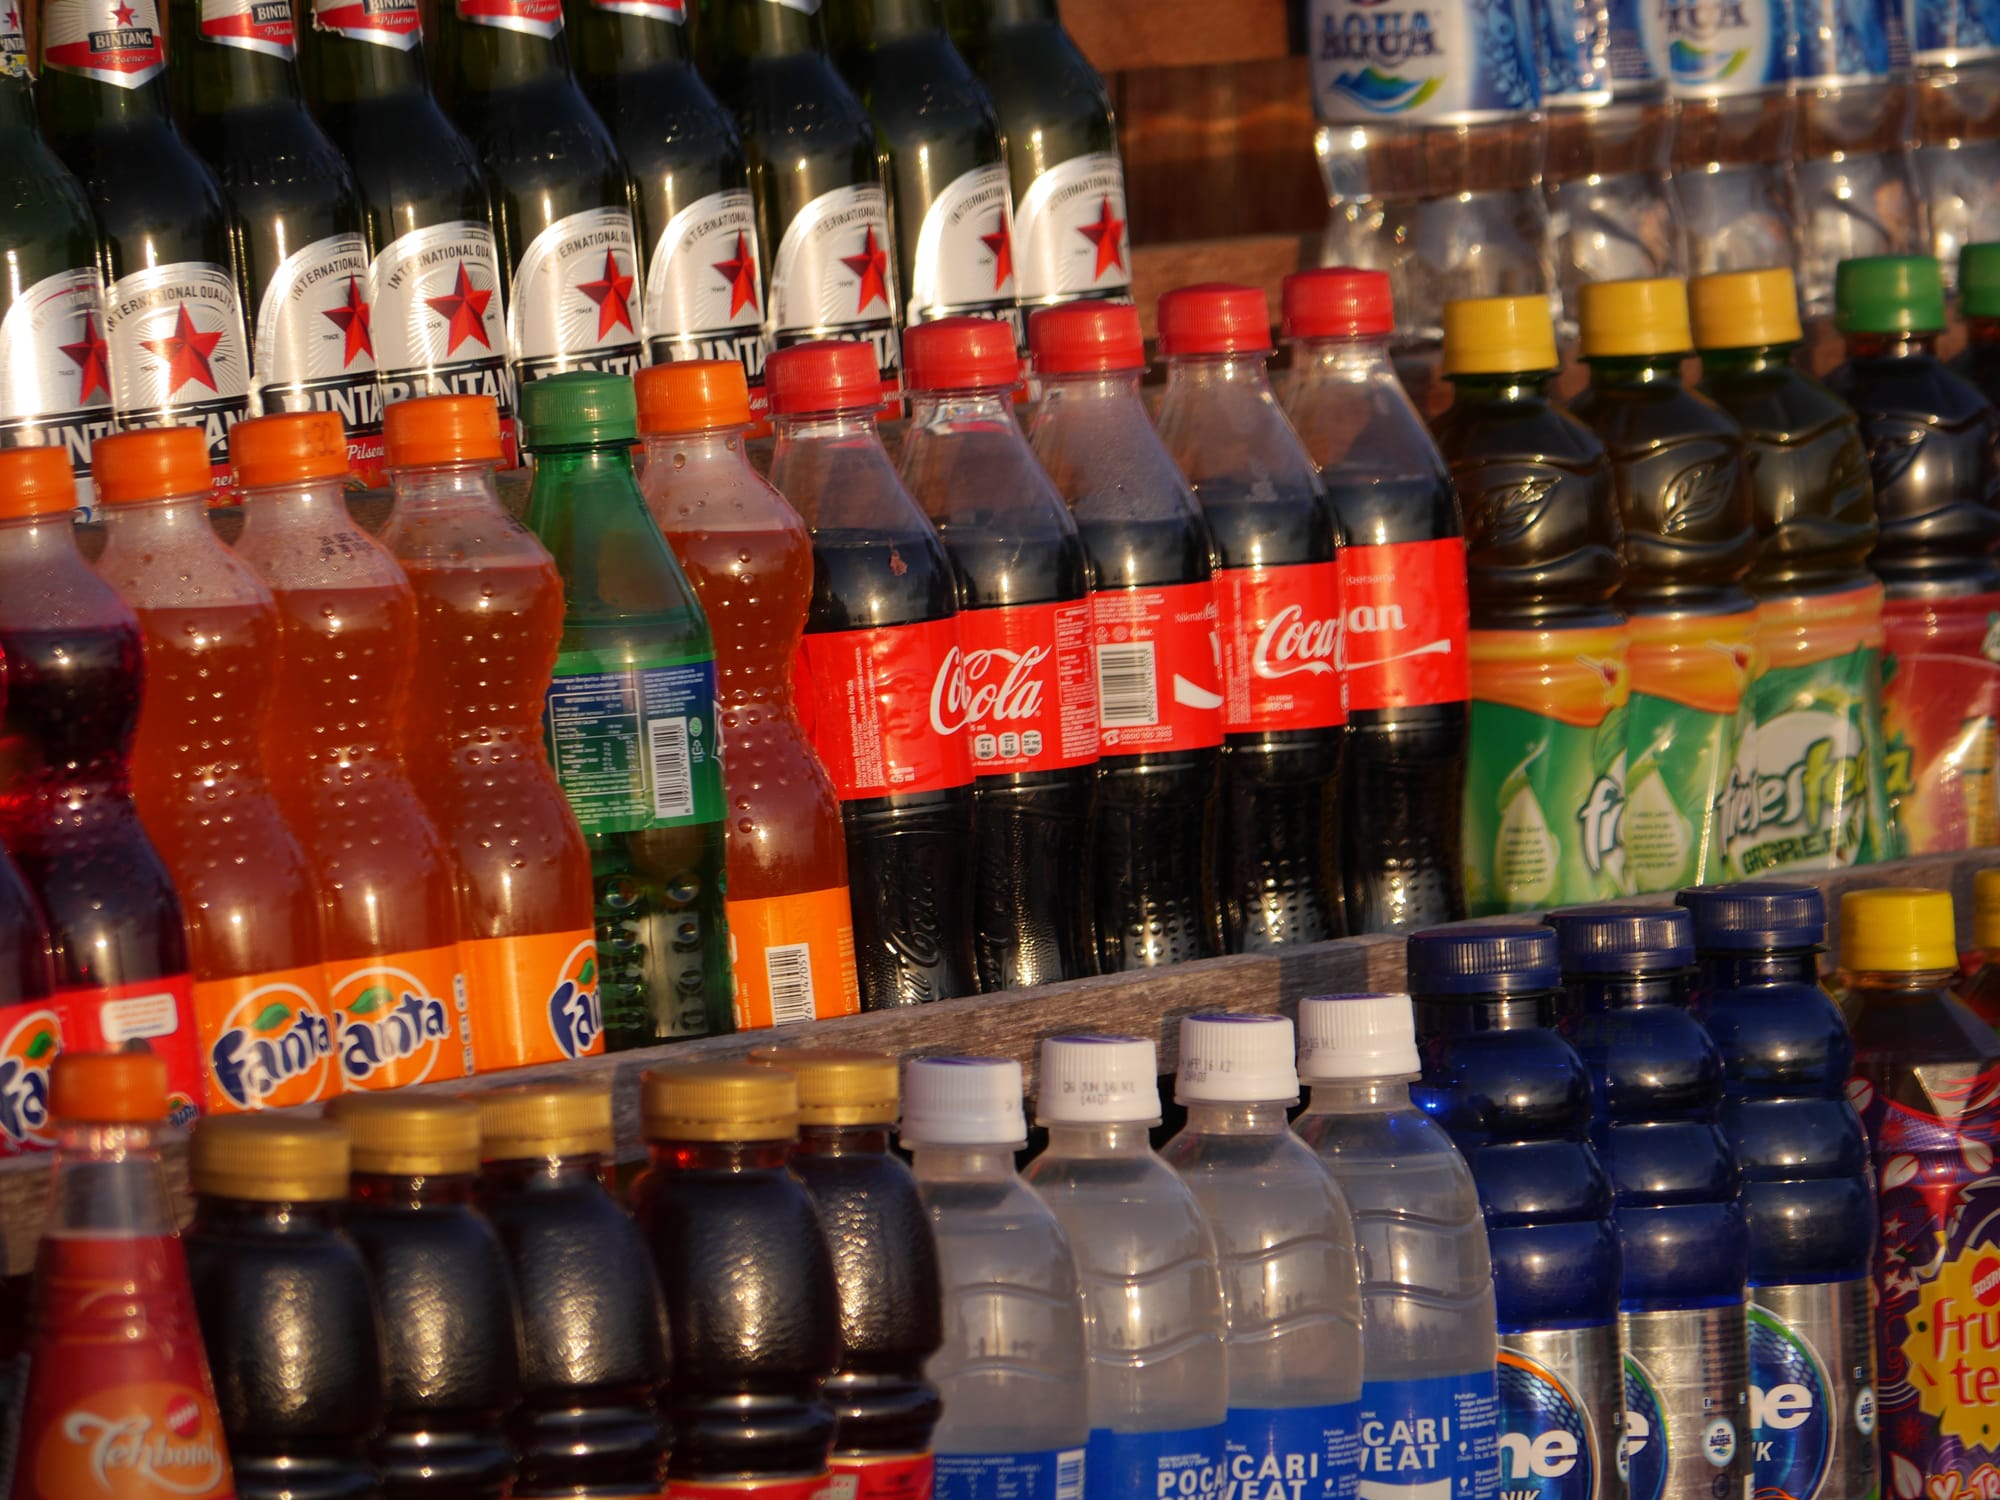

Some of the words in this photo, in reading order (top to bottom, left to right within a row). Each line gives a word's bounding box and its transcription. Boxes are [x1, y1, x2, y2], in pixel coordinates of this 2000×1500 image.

[95, 31, 152, 49] BINTANG
[291, 255, 360, 301] INTERNATIONAL
[388, 243, 474, 290] INTENATIONAL
[107, 286, 198, 333] INTERNIONAL
[1348, 604, 1408, 634] an
[334, 991, 448, 1078] anta
[212, 1009, 332, 1109] Fanta
[0, 1060, 49, 1138] Fa
[1933, 1297, 2000, 1363] fru
[1749, 1383, 1813, 1430] ne
[1949, 1358, 2000, 1409] te
[1362, 1416, 1450, 1447] CARI
[1500, 1429, 1578, 1479] ne
[1231, 1453, 1319, 1480] CARI
